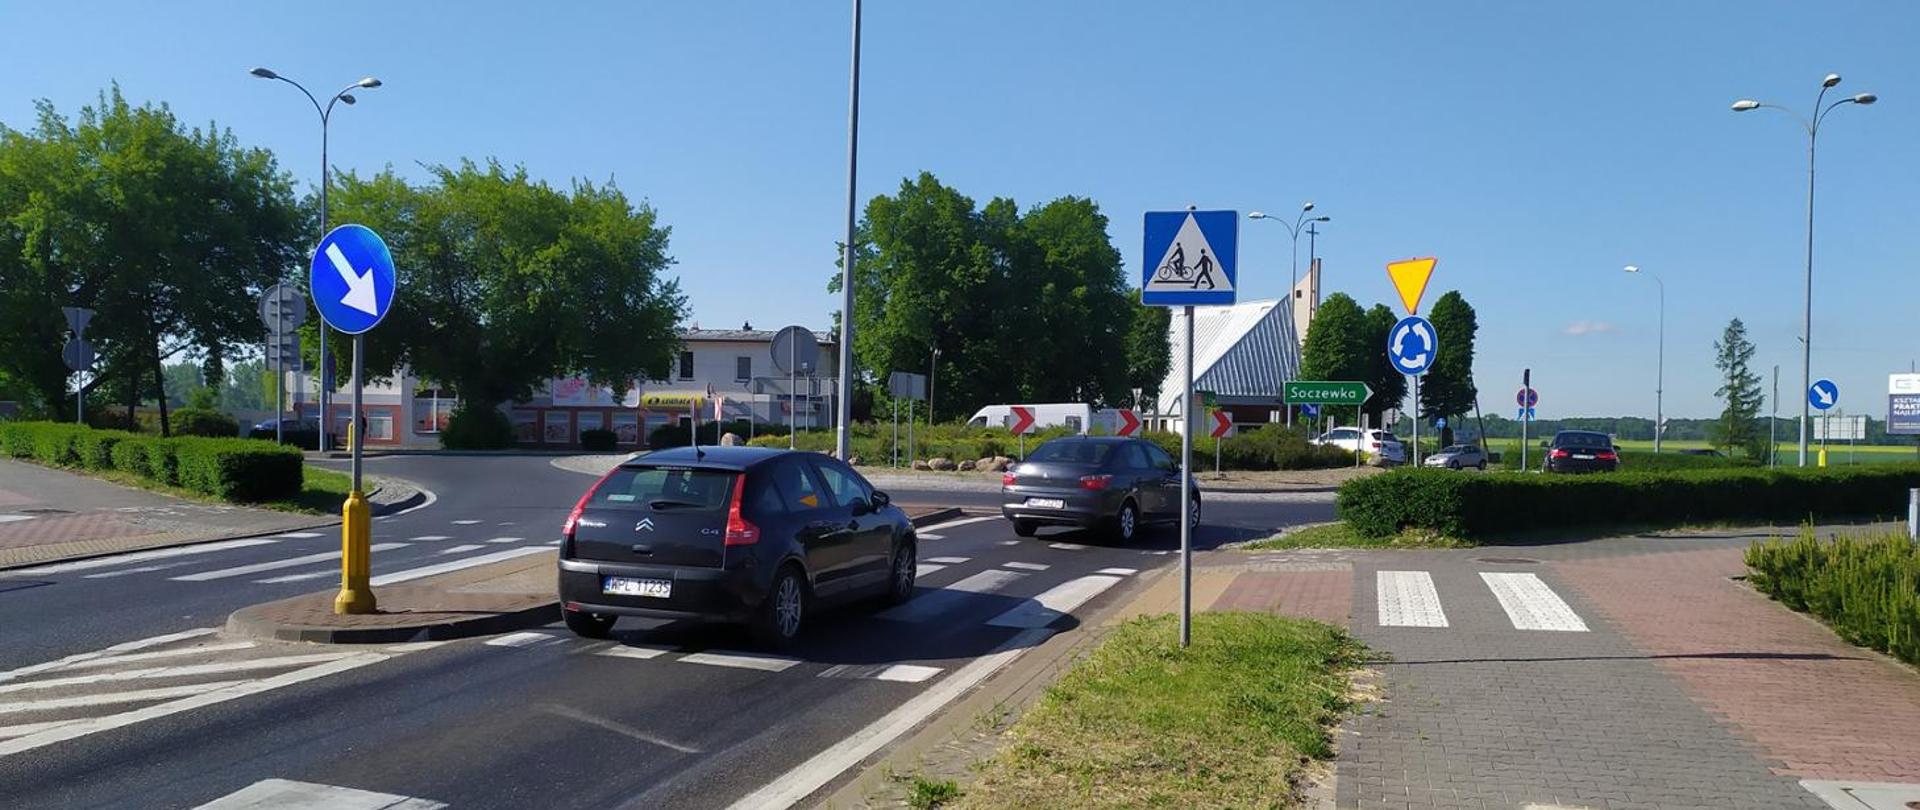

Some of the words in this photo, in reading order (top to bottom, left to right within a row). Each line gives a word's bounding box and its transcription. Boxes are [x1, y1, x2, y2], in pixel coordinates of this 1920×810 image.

[1291, 386, 1356, 399] Soczewka
[611, 577, 632, 591] WPL
[638, 580, 670, 594] 11235
